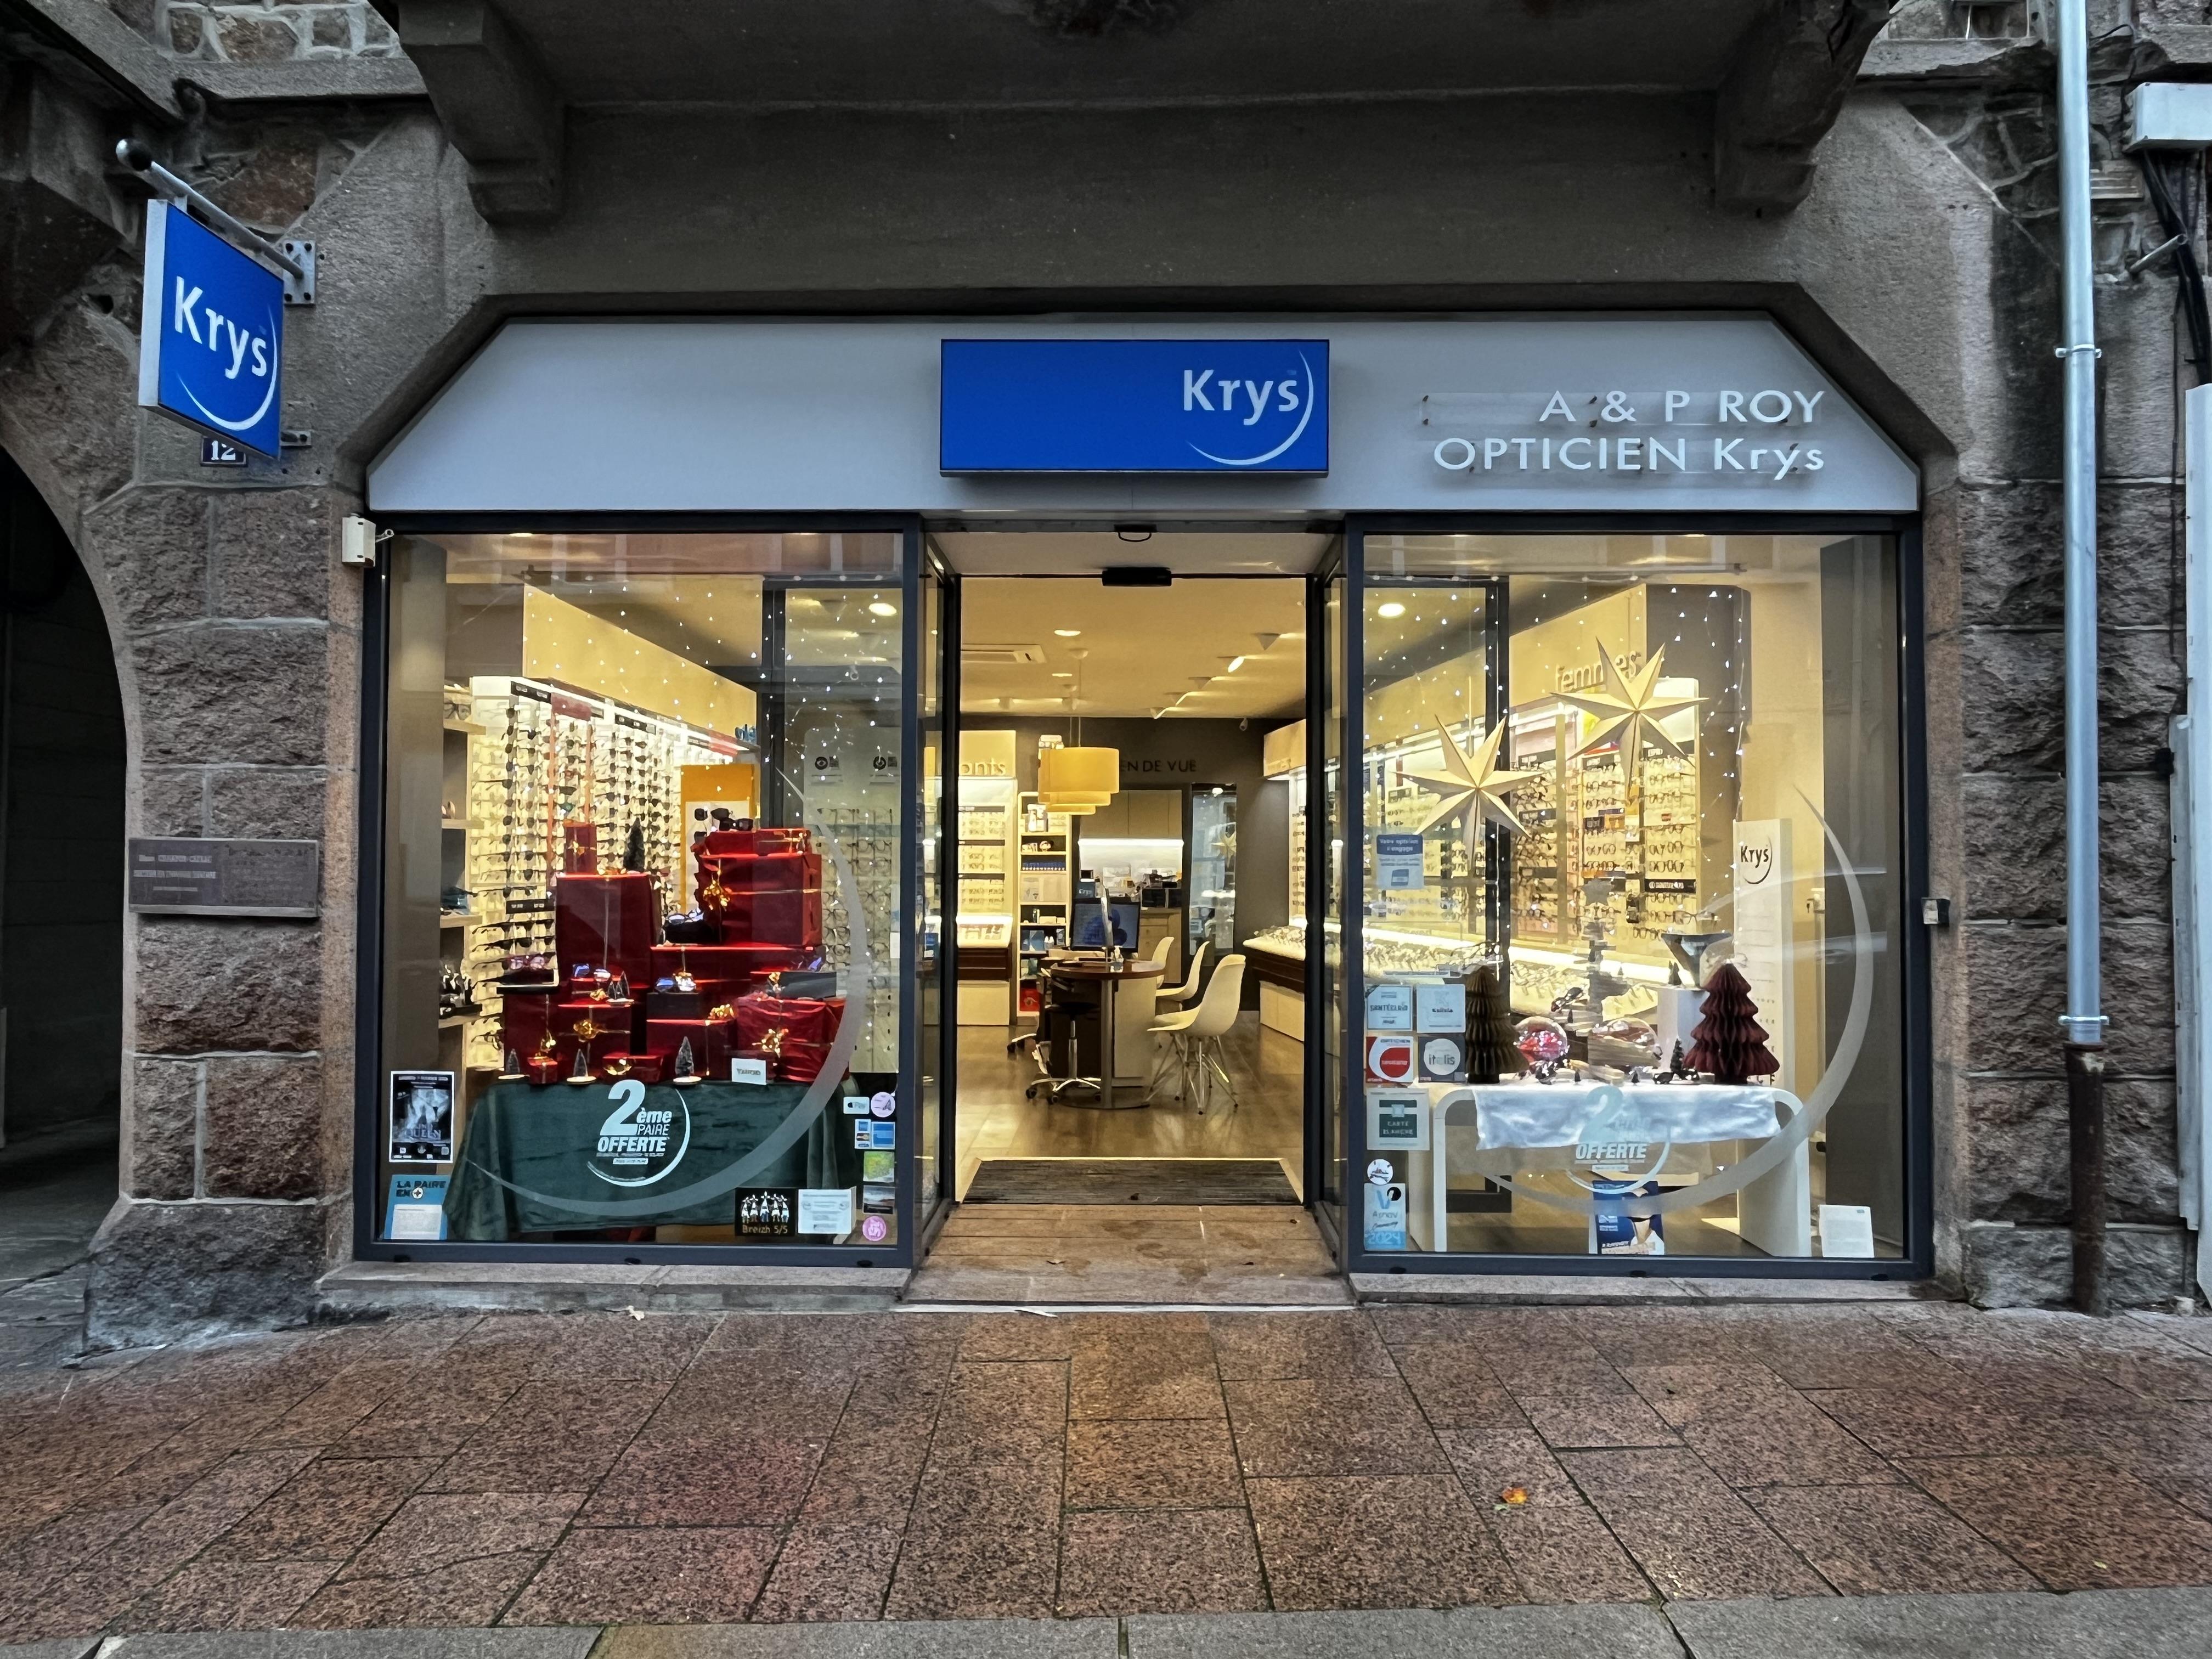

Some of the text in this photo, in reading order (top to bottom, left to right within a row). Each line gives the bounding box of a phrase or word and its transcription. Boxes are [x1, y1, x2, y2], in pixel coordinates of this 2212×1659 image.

[175, 276, 267, 380] Krys
[1183, 370, 1299, 425] Krys
[1539, 390, 1825, 422] A & P ROY
[211, 441, 236, 460] 12
[1434, 437, 1824, 480] OPTICIEN Krys
[1143, 760, 1161, 772] DE
[1167, 760, 1197, 772] VUE
[1741, 845, 1769, 868] Krys
[637, 1124, 670, 1136] PAIRE
[597, 1137, 666, 1152] OFFERTE
[1576, 1143, 1647, 1159] OFFERTE
[742, 1224, 788, 1234] Breizh 5/5
